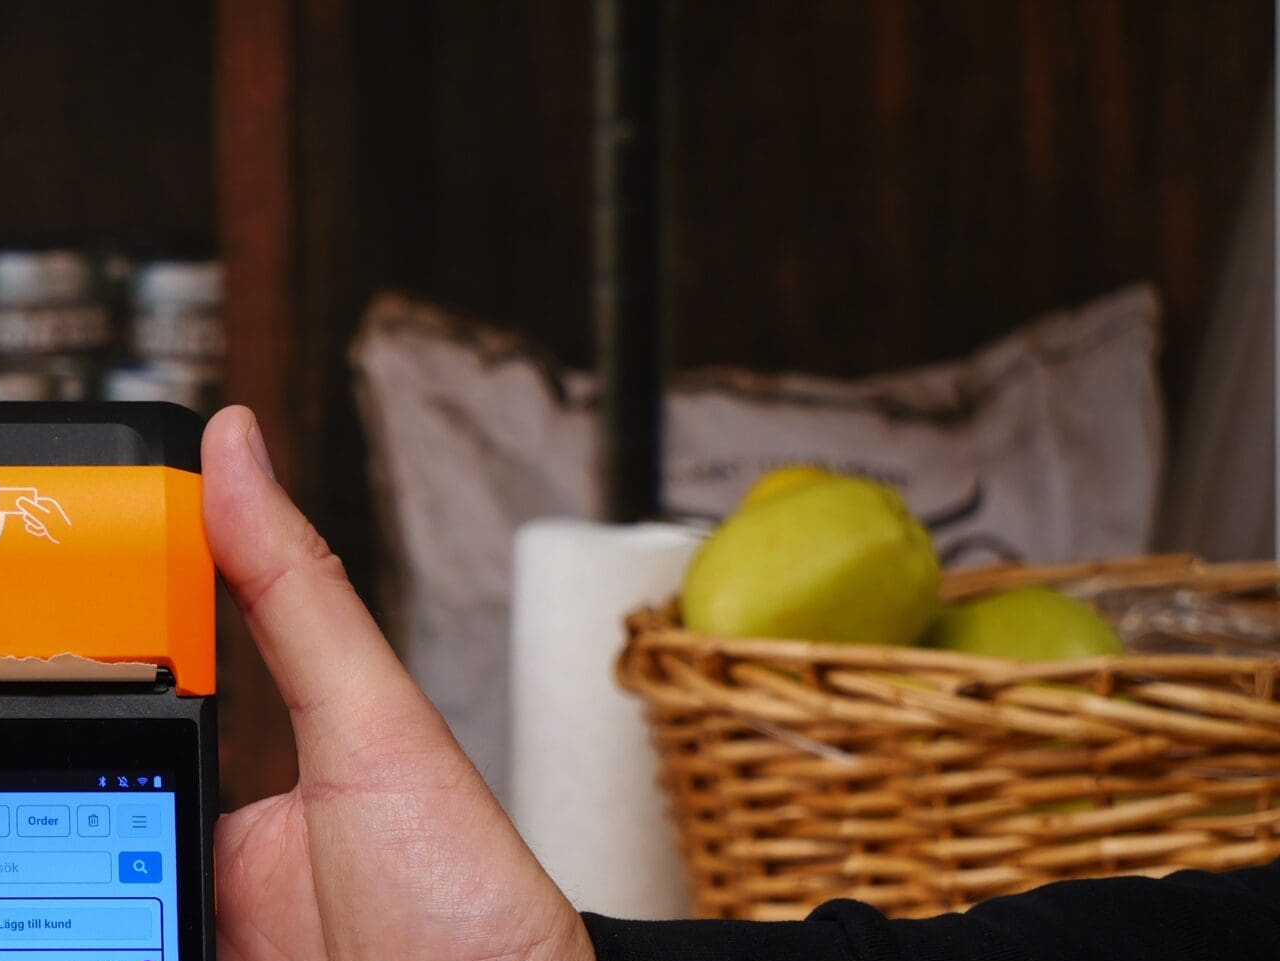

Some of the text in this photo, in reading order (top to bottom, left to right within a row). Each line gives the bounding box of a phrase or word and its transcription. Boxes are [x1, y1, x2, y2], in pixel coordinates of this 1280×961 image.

[28, 815, 59, 826] Order
[27, 918, 42, 929] till
[44, 918, 72, 929] kund
